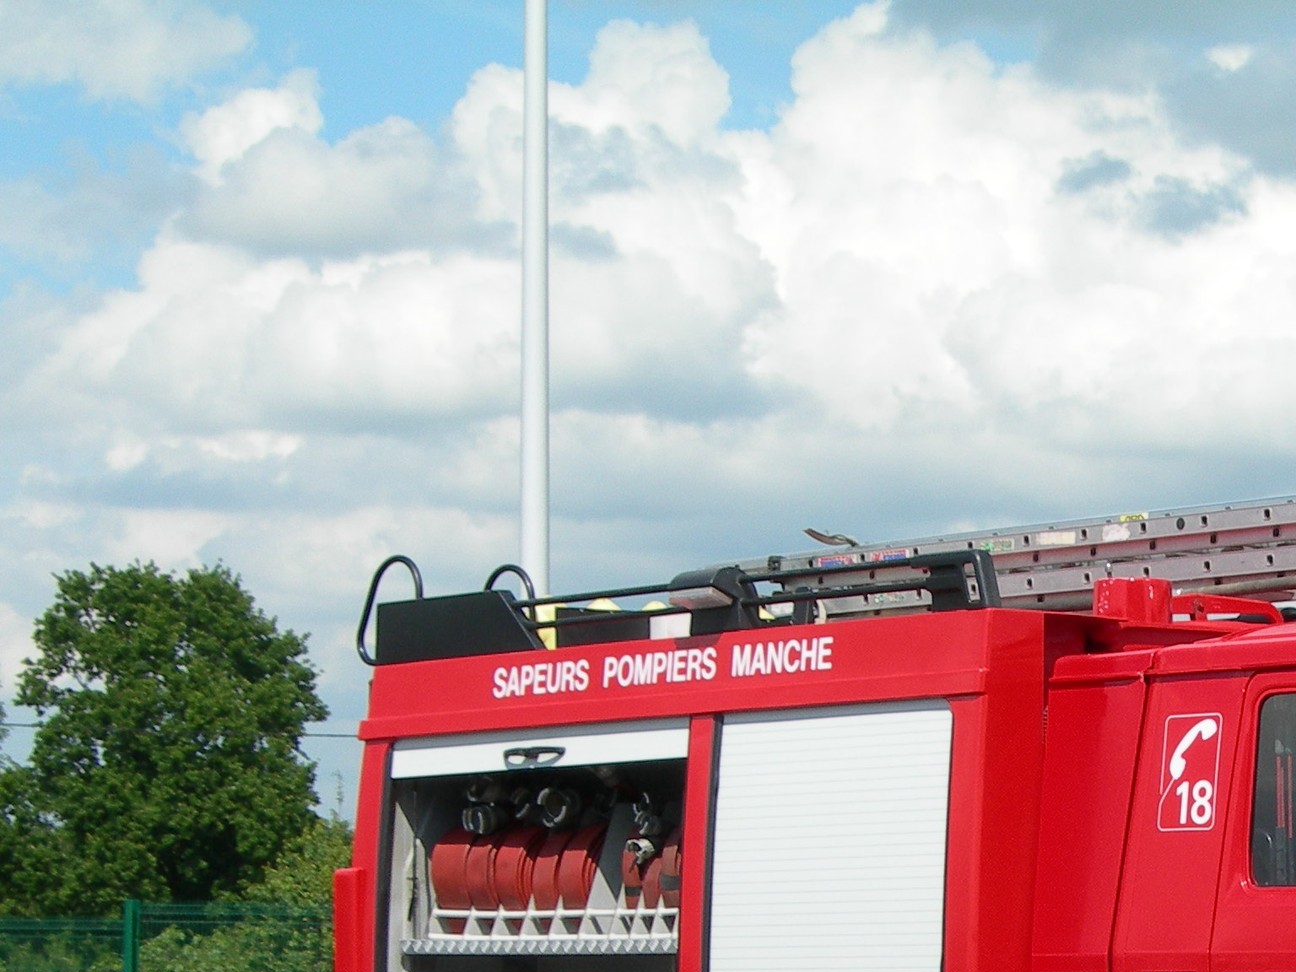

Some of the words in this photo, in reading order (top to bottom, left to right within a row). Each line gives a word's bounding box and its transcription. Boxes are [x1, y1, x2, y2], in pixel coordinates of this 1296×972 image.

[493, 659, 590, 698] SAPEURS
[602, 647, 717, 689] POMPIERS
[731, 637, 834, 677] MANCHE
[1176, 780, 1213, 825] 18
